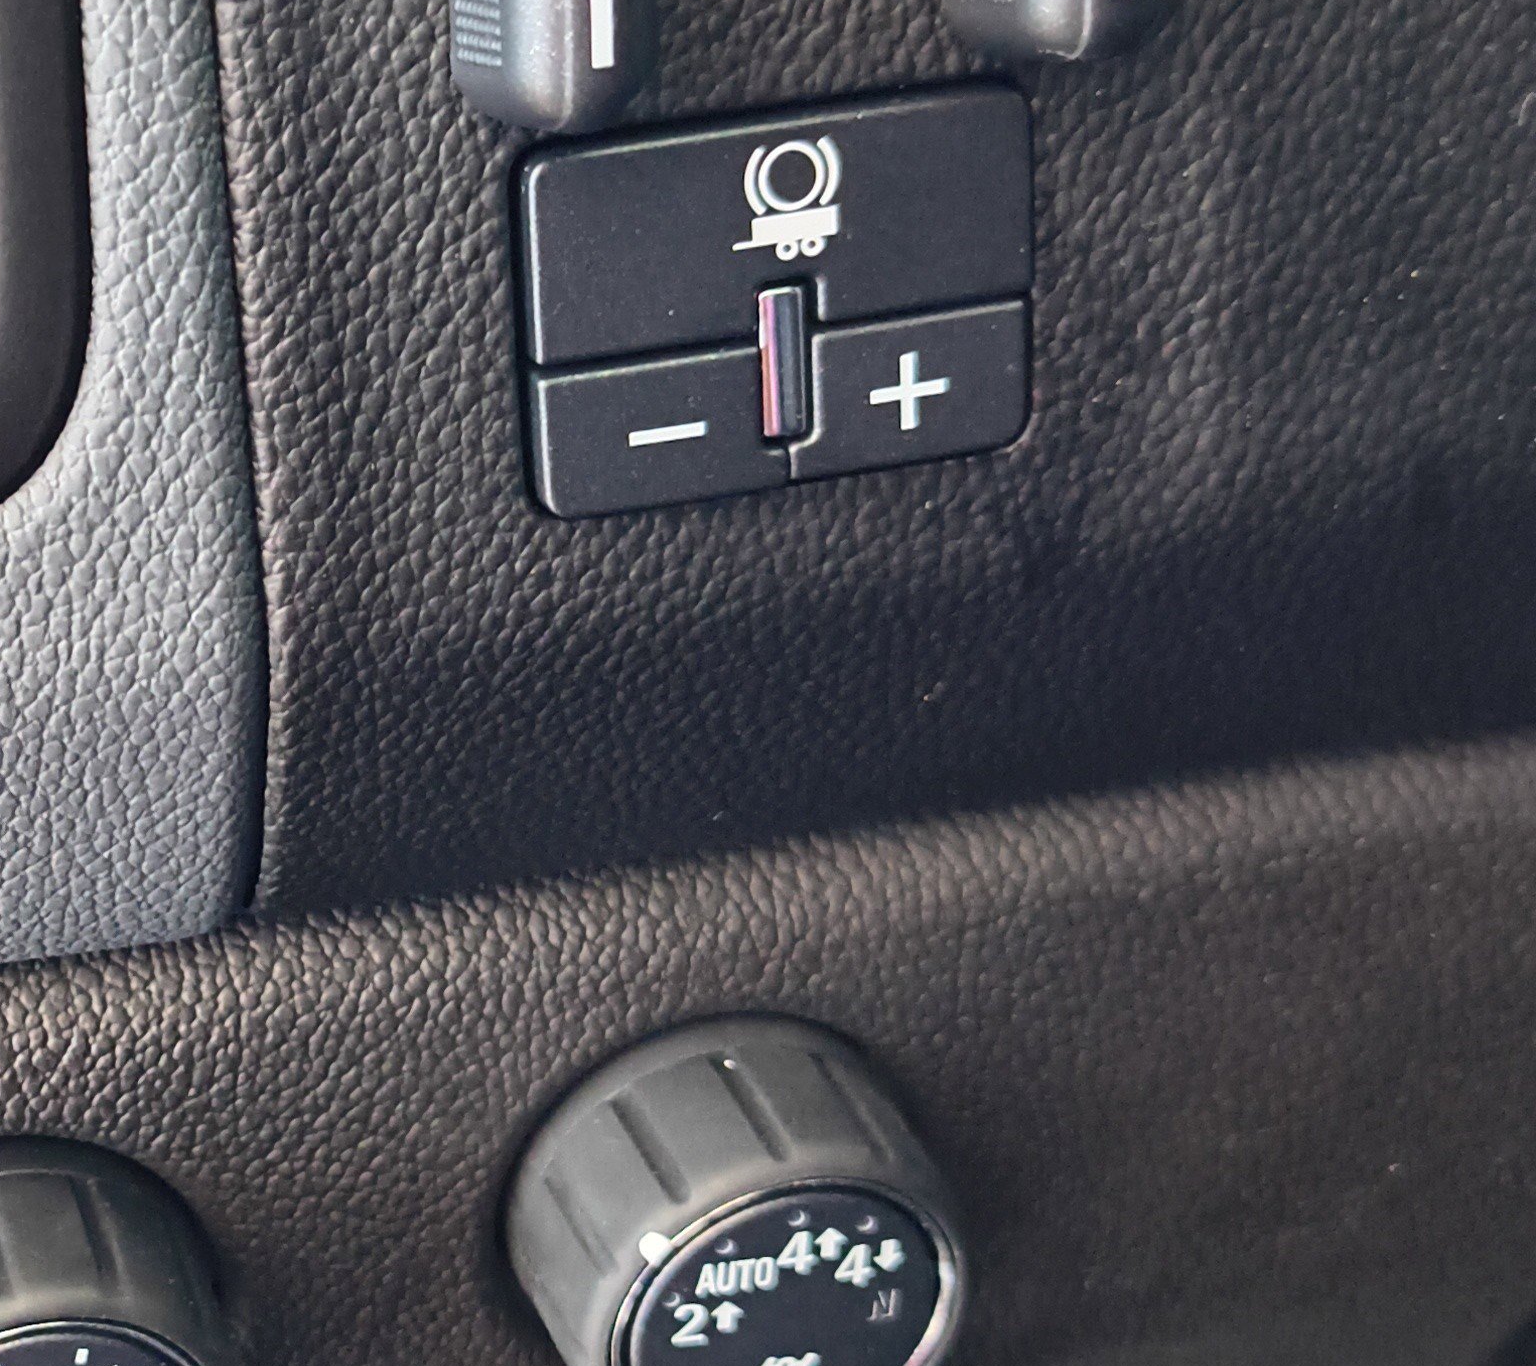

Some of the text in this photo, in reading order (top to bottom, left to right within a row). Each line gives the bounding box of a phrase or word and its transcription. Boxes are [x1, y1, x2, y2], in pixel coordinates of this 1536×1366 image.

[776, 1230, 819, 1275] 4
[834, 1243, 876, 1288] 4
[695, 1256, 779, 1299] AUTO
[670, 1303, 710, 1348] 2
[866, 1288, 902, 1323] N
